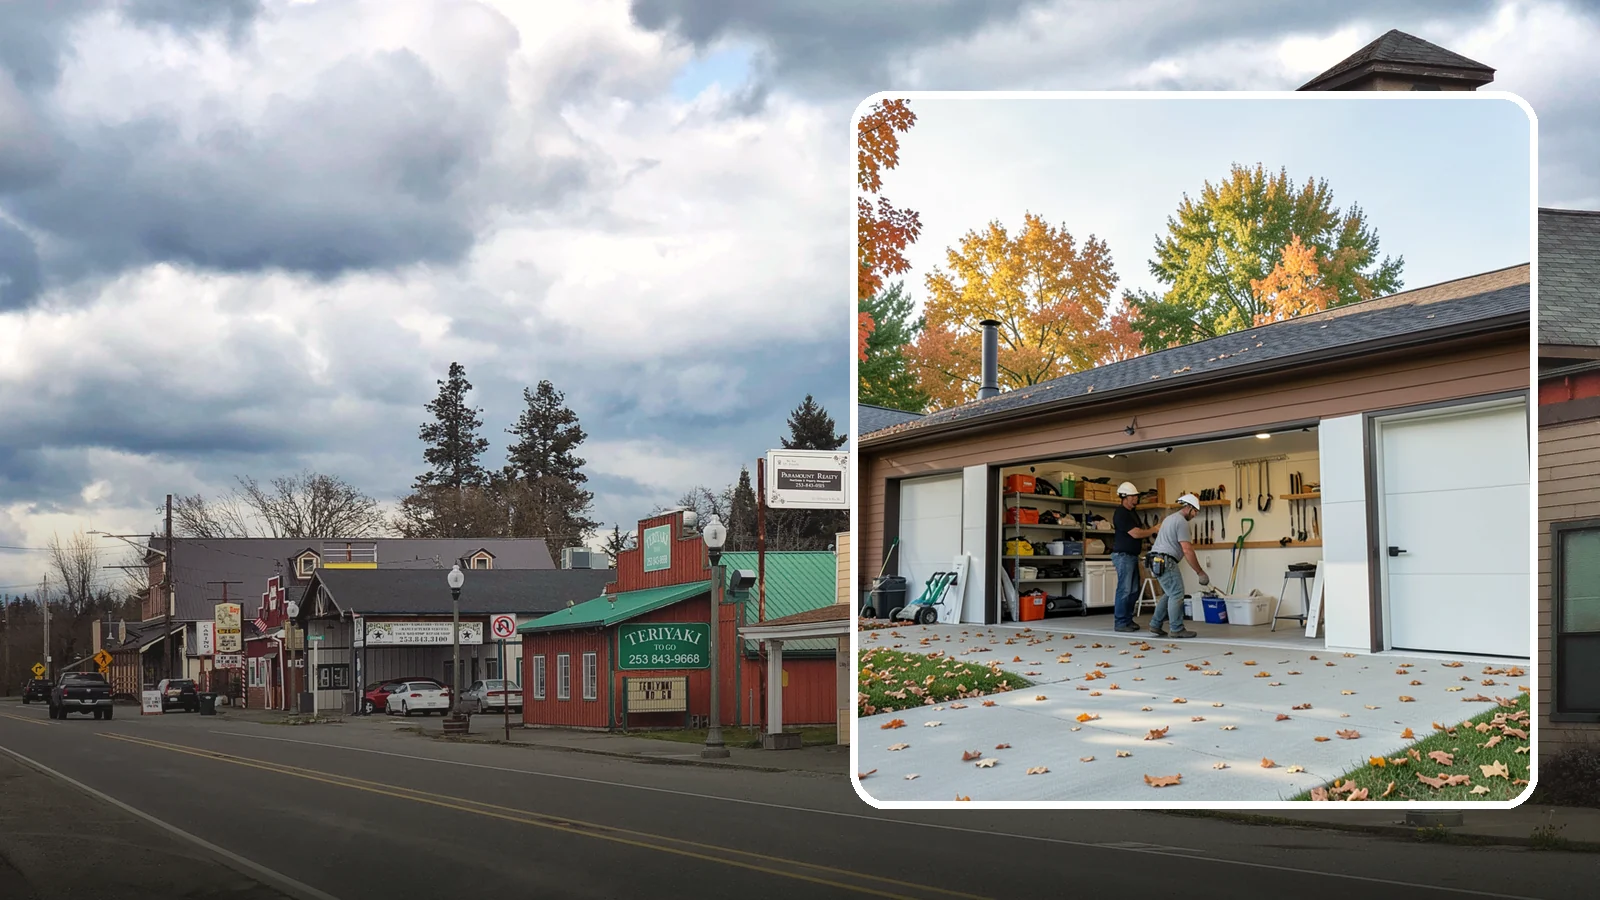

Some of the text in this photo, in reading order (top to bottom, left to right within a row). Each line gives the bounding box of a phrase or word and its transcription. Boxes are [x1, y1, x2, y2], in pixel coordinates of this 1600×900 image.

[624, 628, 702, 646] TERIYAKI
[629, 654, 700, 664] 253 843-9668
[639, 681, 672, 690] TERIYAKI
